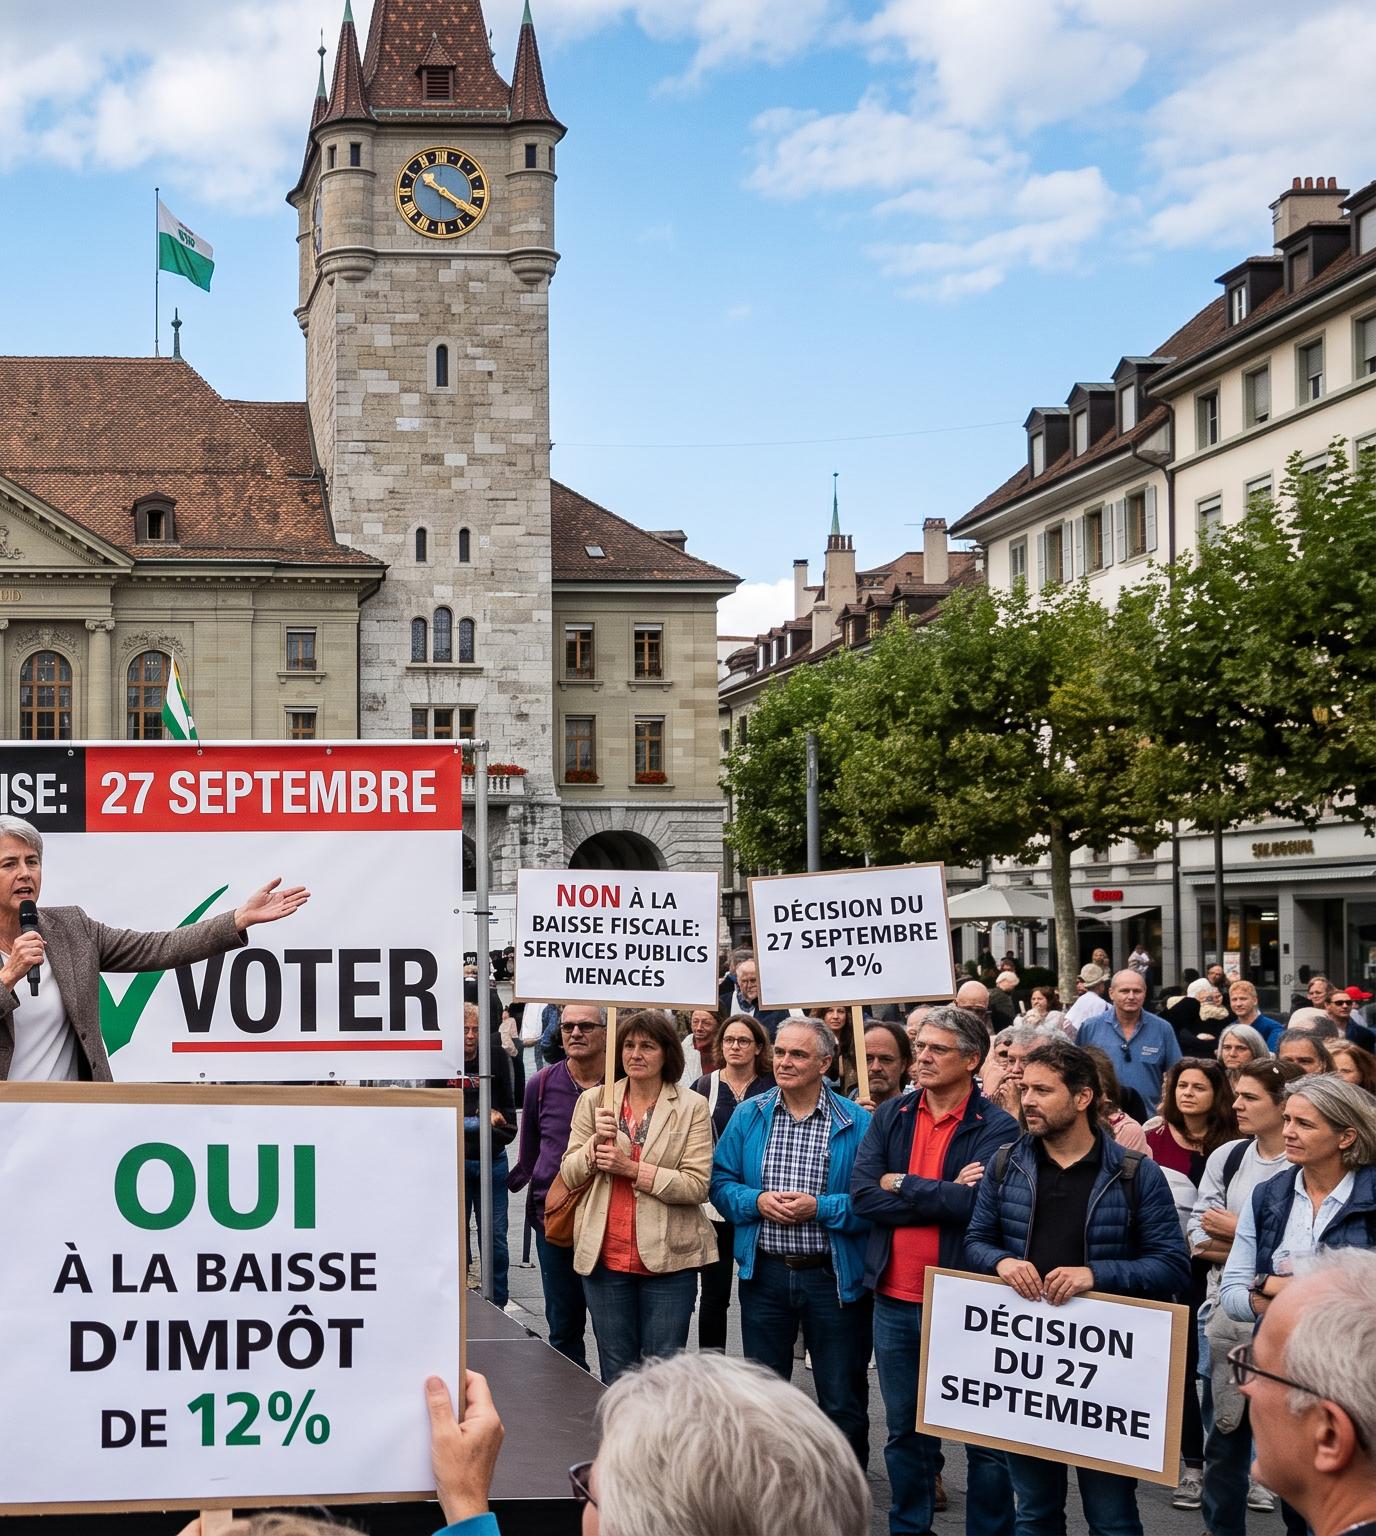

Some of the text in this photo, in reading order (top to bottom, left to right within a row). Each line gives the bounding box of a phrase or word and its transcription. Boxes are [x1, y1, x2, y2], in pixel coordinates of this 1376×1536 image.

[102, 770, 436, 814] 27 SEPTEMBRE
[558, 884, 677, 909] NON À LA
[774, 895, 923, 923] DÉCISION DU
[533, 916, 699, 936] BAISSE FISCALE:
[767, 922, 937, 951] 27 SEPTEMBRE
[524, 941, 707, 963] SERVICES PUBLICS
[825, 953, 882, 977] 12%
[175, 948, 440, 1033] VOTER
[566, 966, 664, 987] MENACÉS
[115, 1142, 315, 1230] OUI
[53, 1242, 376, 1293] À LA BAISSE
[70, 1305, 364, 1372] D'IMPÔT
[965, 1304, 1133, 1359] DÉCISION
[995, 1347, 1097, 1389] DU 27
[102, 1389, 330, 1448] DE 12%
[940, 1375, 1150, 1440] SEPTEMBRE
